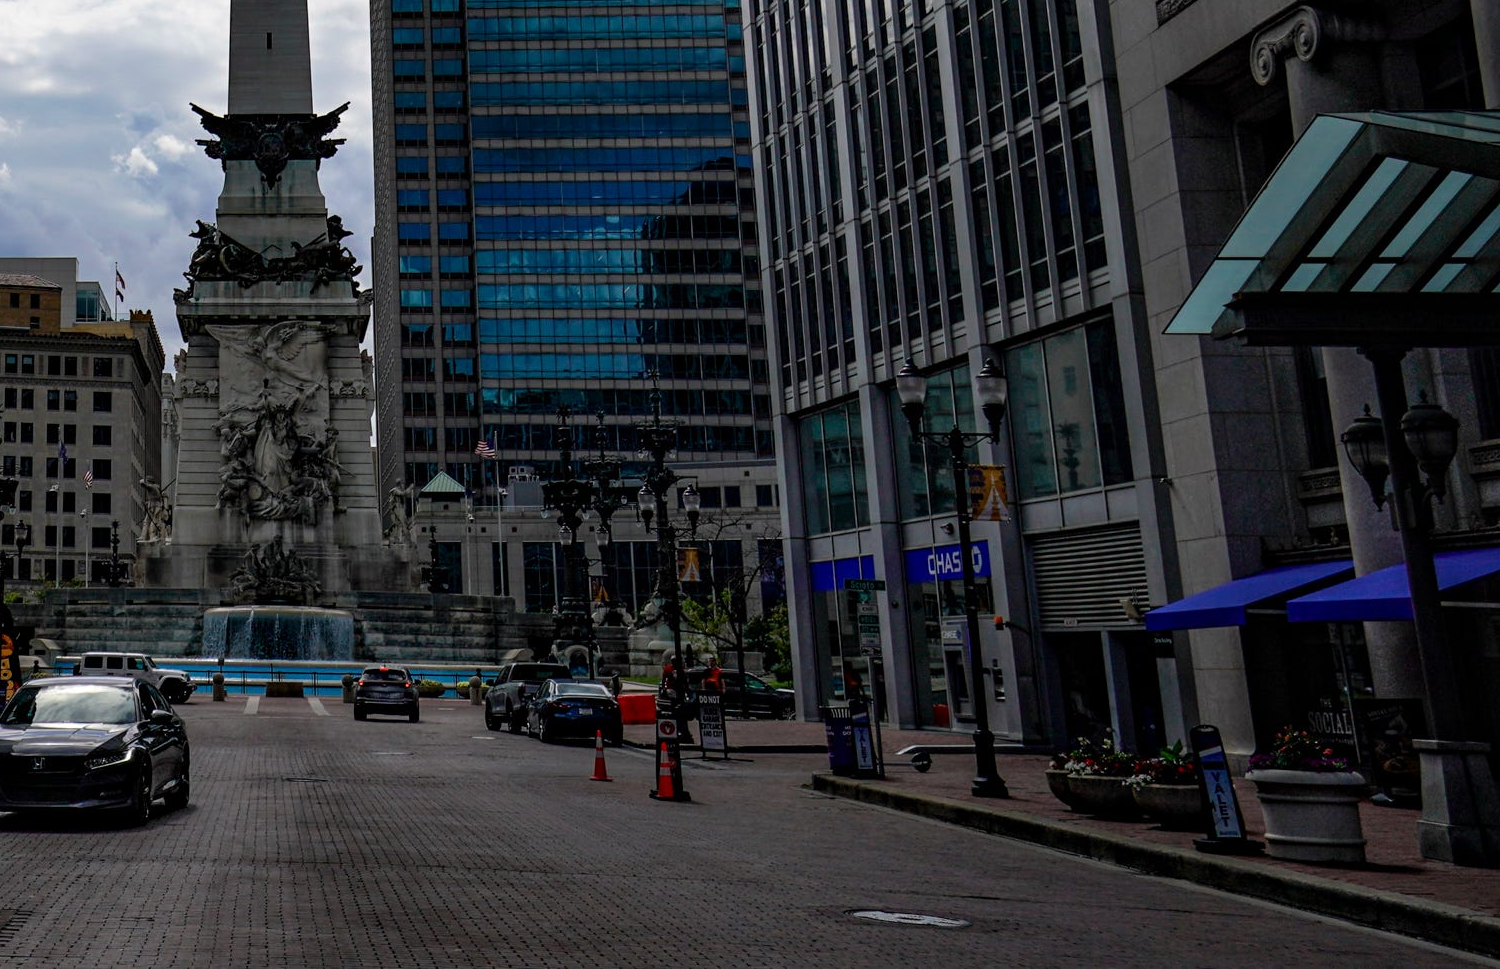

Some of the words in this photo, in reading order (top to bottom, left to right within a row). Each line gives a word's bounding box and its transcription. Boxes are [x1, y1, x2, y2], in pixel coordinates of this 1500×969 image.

[850, 580, 875, 590] Scioto
[699, 695, 708, 704] DO
[709, 695, 720, 704] NOT
[1307, 710, 1353, 735] SOCIAL
[1211, 771, 1230, 827] VALET
